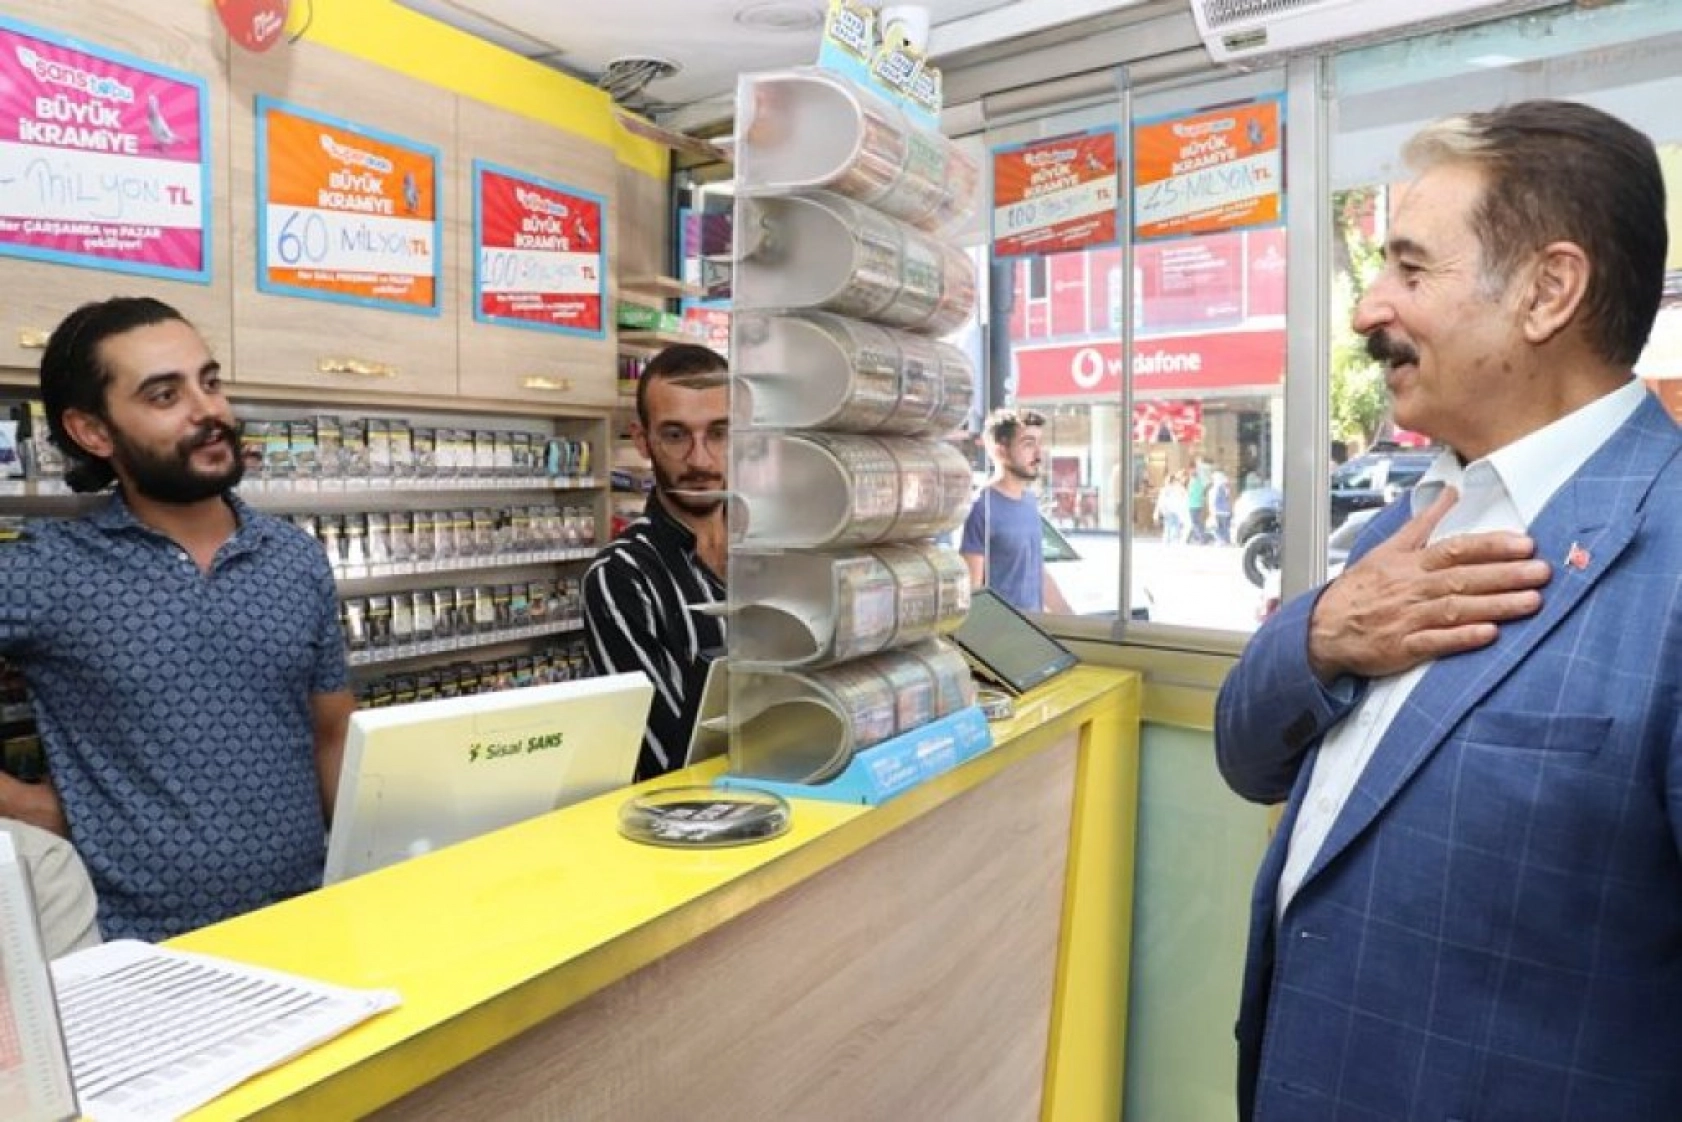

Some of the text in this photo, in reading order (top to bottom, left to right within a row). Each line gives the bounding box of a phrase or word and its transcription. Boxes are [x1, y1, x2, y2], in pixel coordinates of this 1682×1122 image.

[35, 95, 122, 128] BÜYÜK
[19, 117, 139, 154] İKRAMİYE
[1179, 133, 1228, 159] BÜYÜK
[328, 168, 384, 195] BÜYÜK
[1255, 167, 1271, 181] TL
[166, 185, 193, 205] TL
[317, 189, 394, 216] İKRAMİYE
[521, 213, 563, 235] BÜYÜK
[278, 210, 328, 265] 60
[410, 239, 429, 256] TL
[1107, 350, 1202, 376] vdafone
